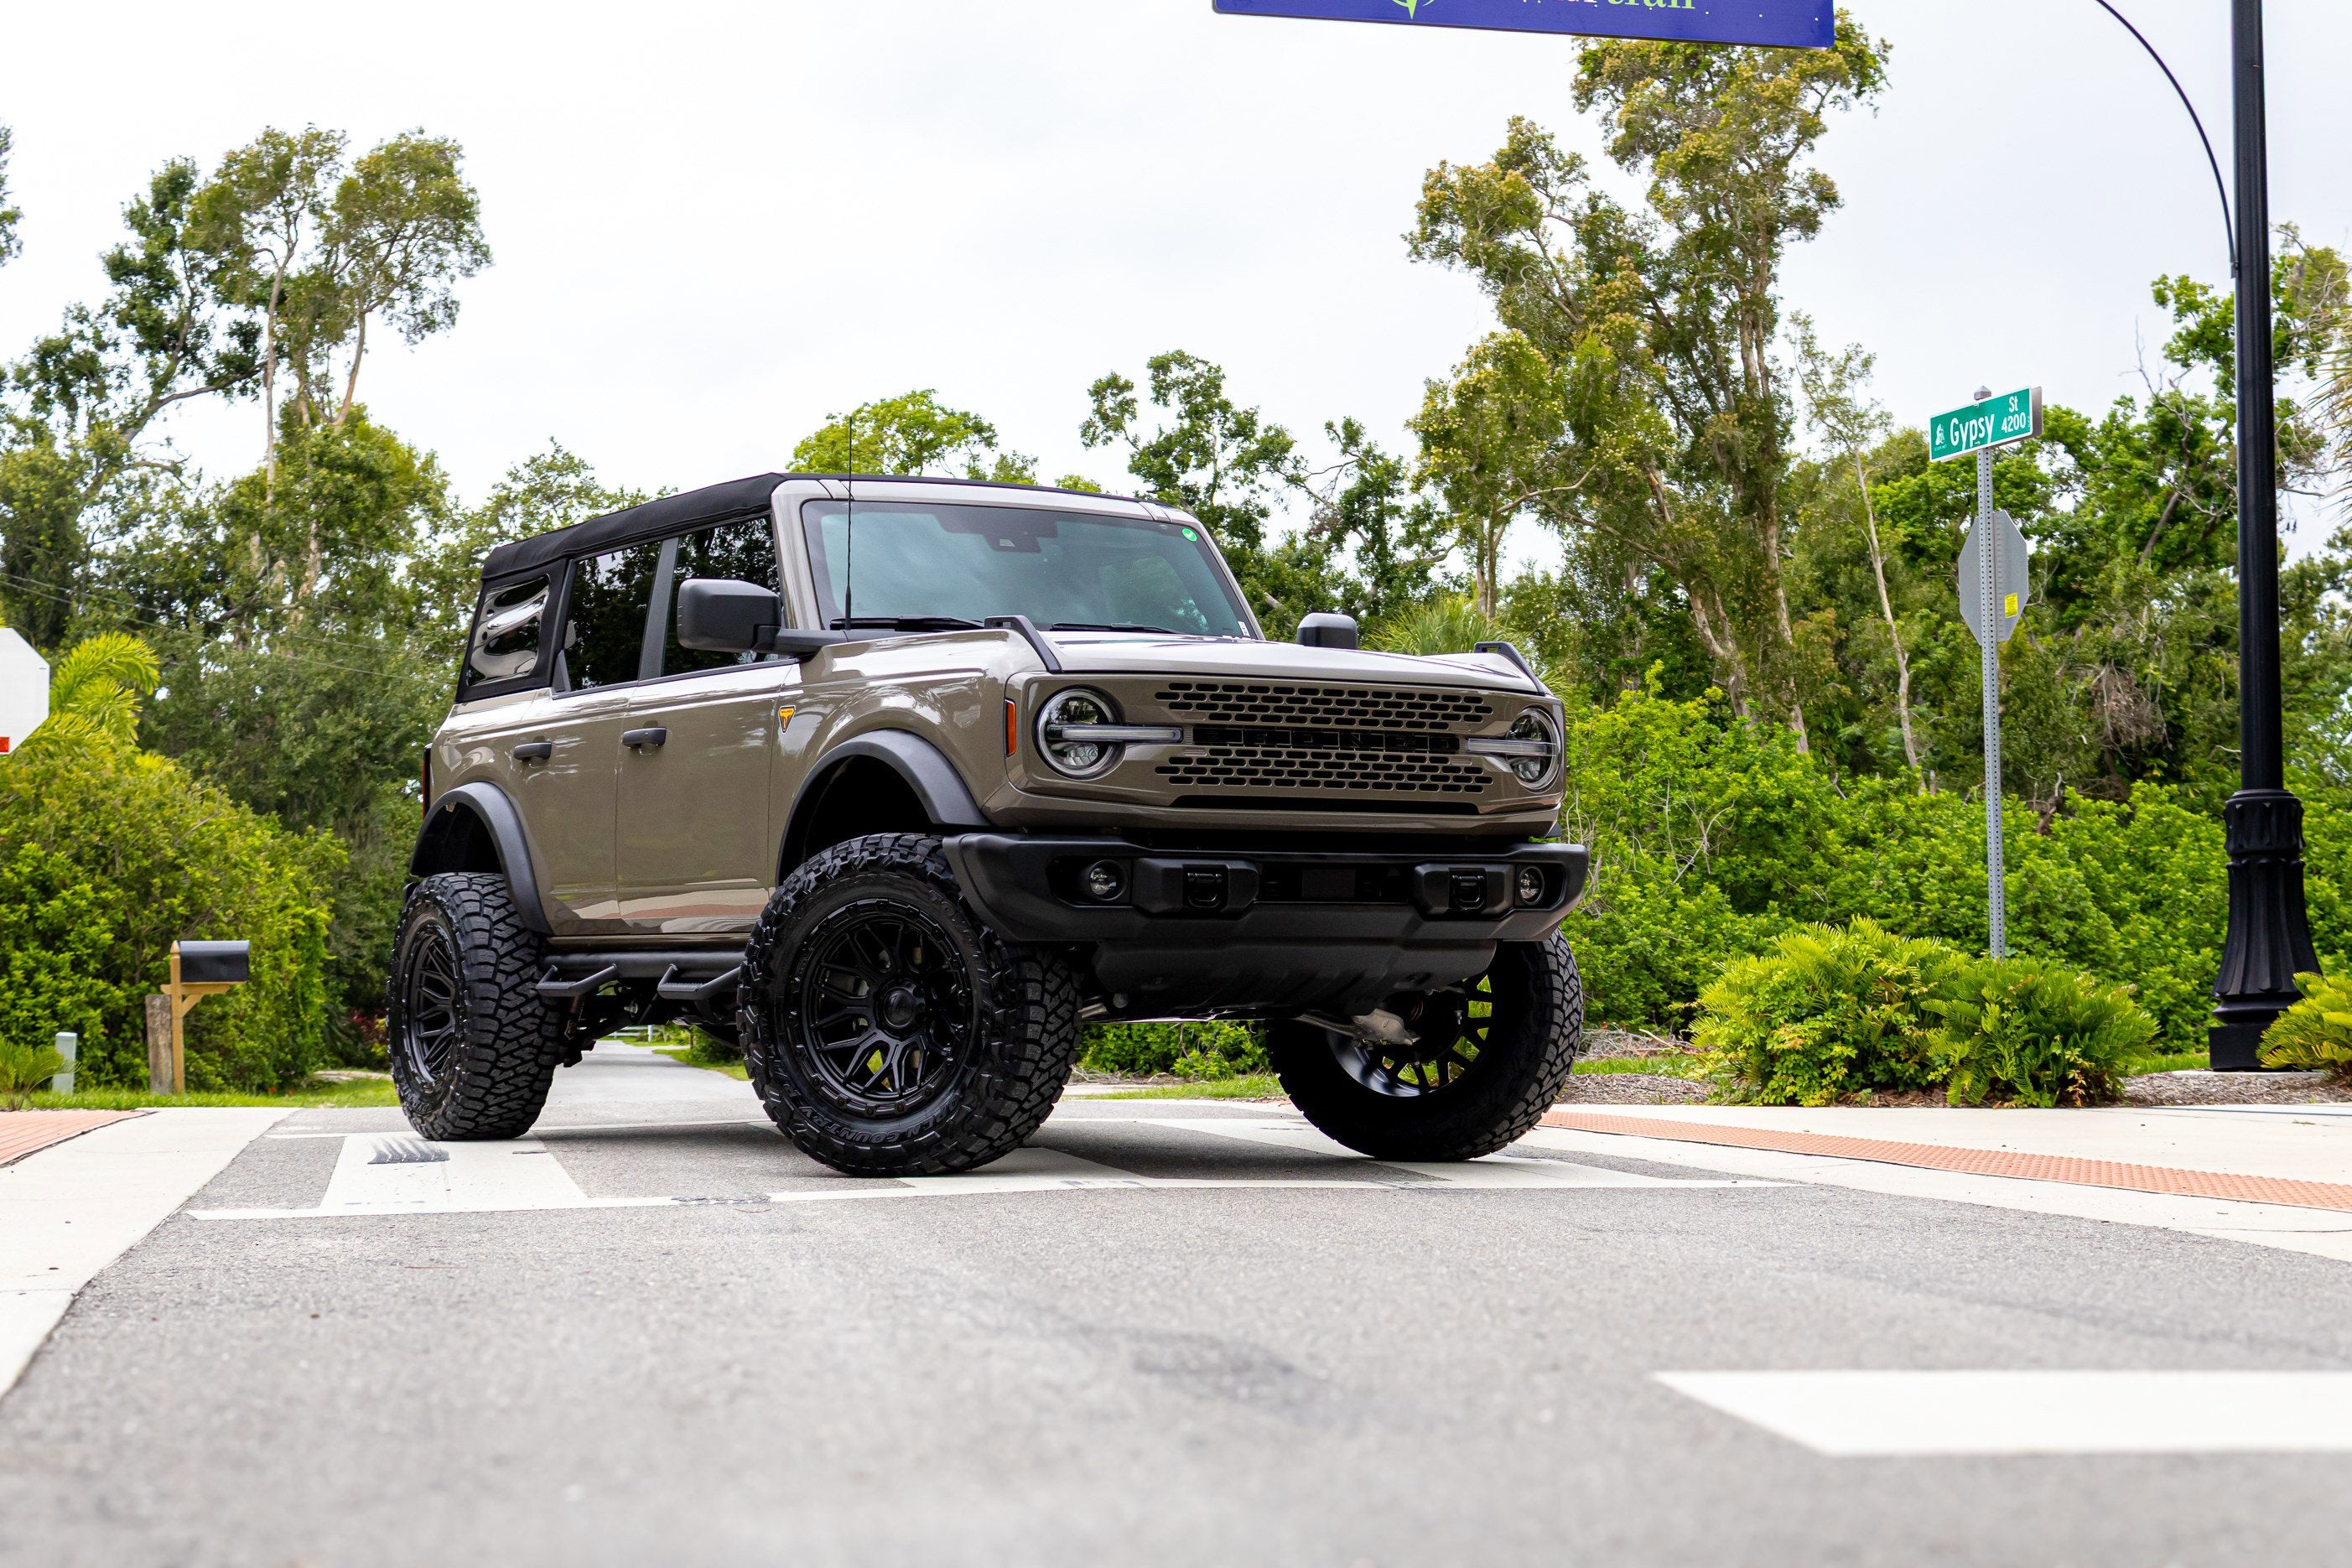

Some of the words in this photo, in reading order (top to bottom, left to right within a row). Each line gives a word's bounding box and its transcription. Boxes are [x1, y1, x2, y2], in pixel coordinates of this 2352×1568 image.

[2009, 397, 2018, 412] St
[1950, 414, 1995, 451] Gypsy
[2002, 413, 2026, 433] 4200
[799, 1105, 901, 1144] COUNTRY
